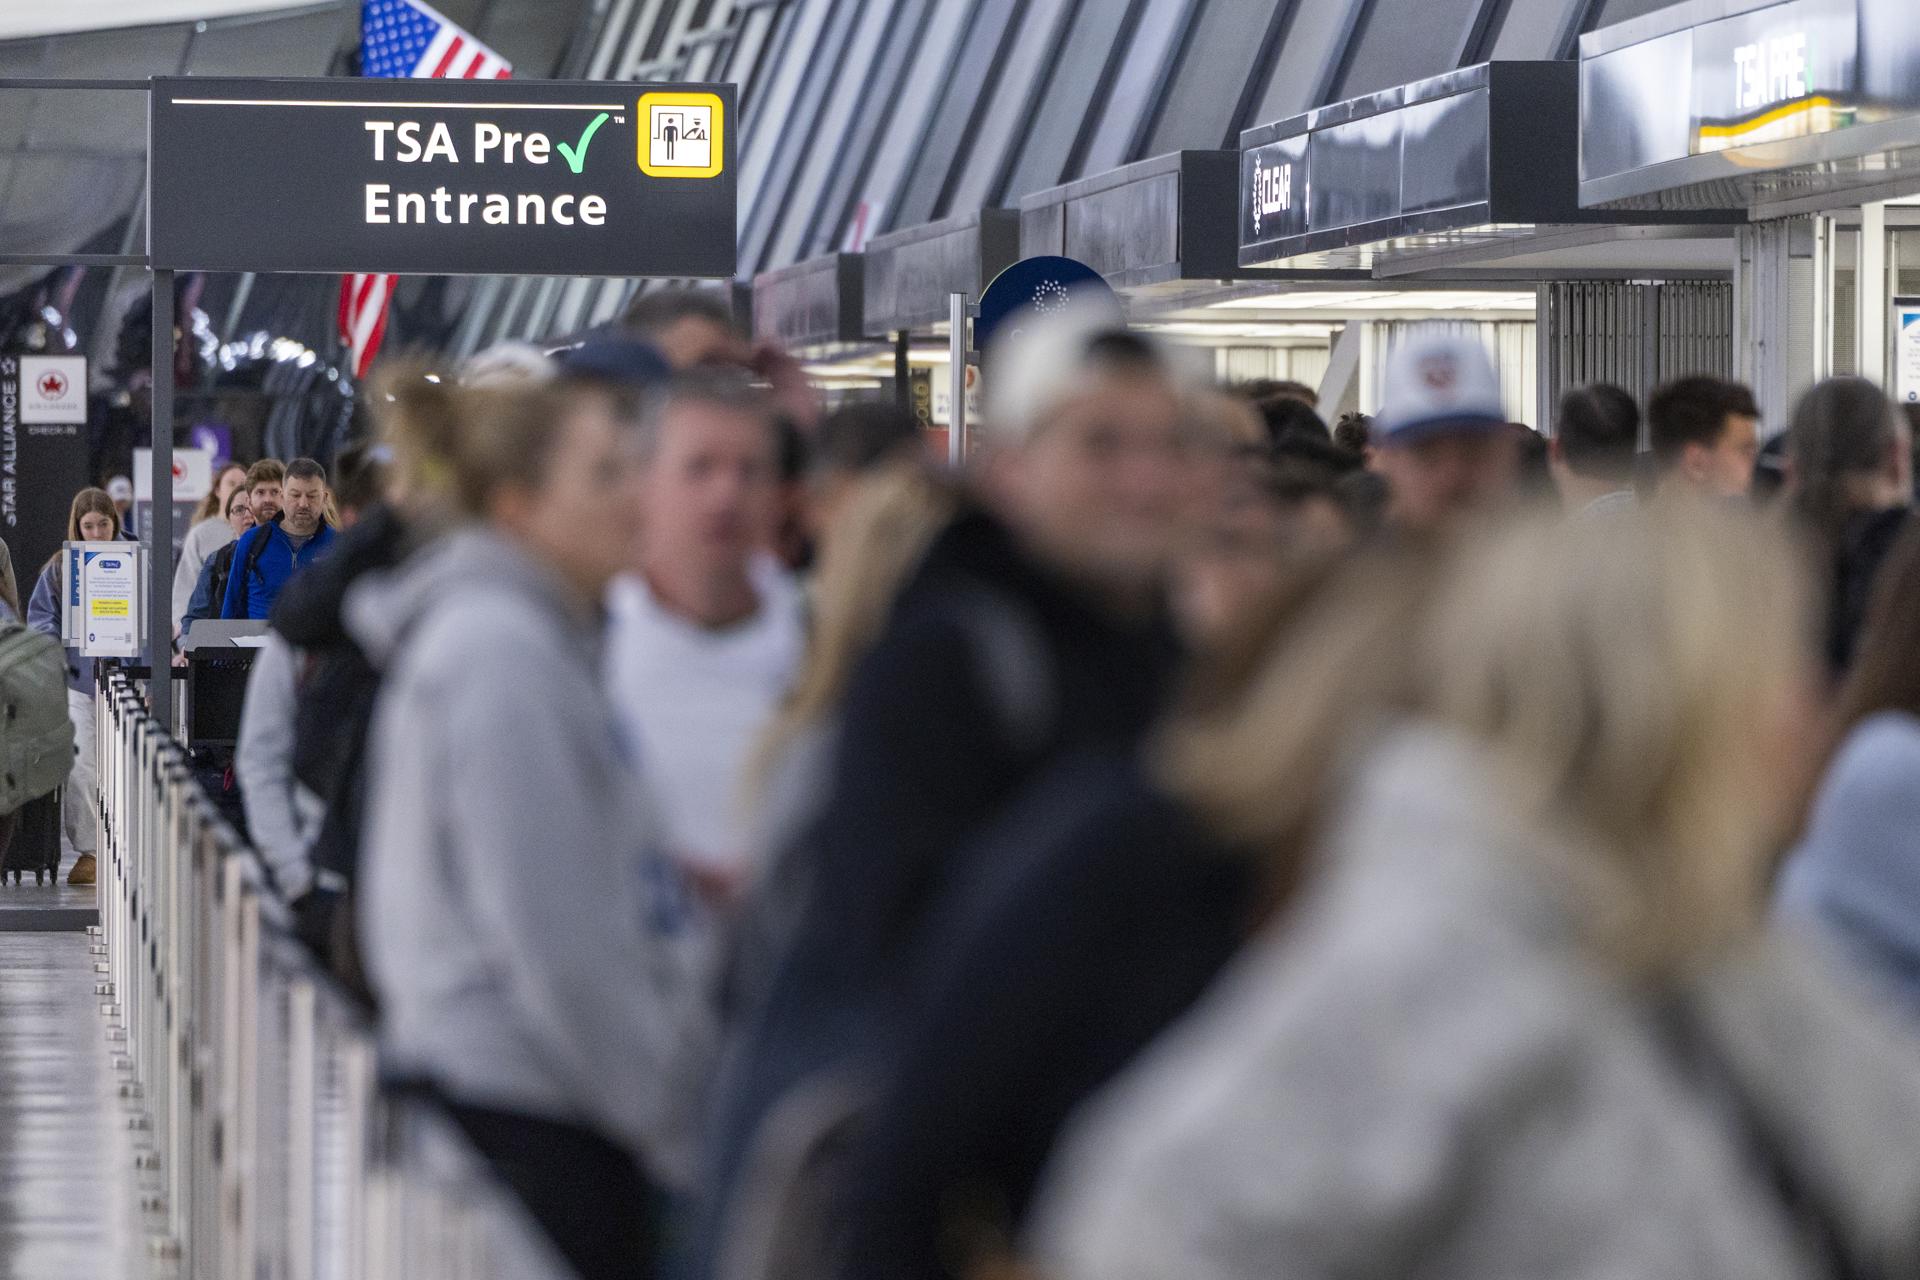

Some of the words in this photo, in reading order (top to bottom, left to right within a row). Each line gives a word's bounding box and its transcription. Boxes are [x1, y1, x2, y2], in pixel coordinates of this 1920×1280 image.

[1733, 42, 1768, 110] TSA
[364, 121, 460, 164] TSA
[474, 122, 551, 165] Pre
[364, 183, 608, 227] Entrance
[1262, 163, 1292, 215] CLEAR
[2, 380, 17, 475] ALLIANCE
[2, 477, 17, 528] STAR
